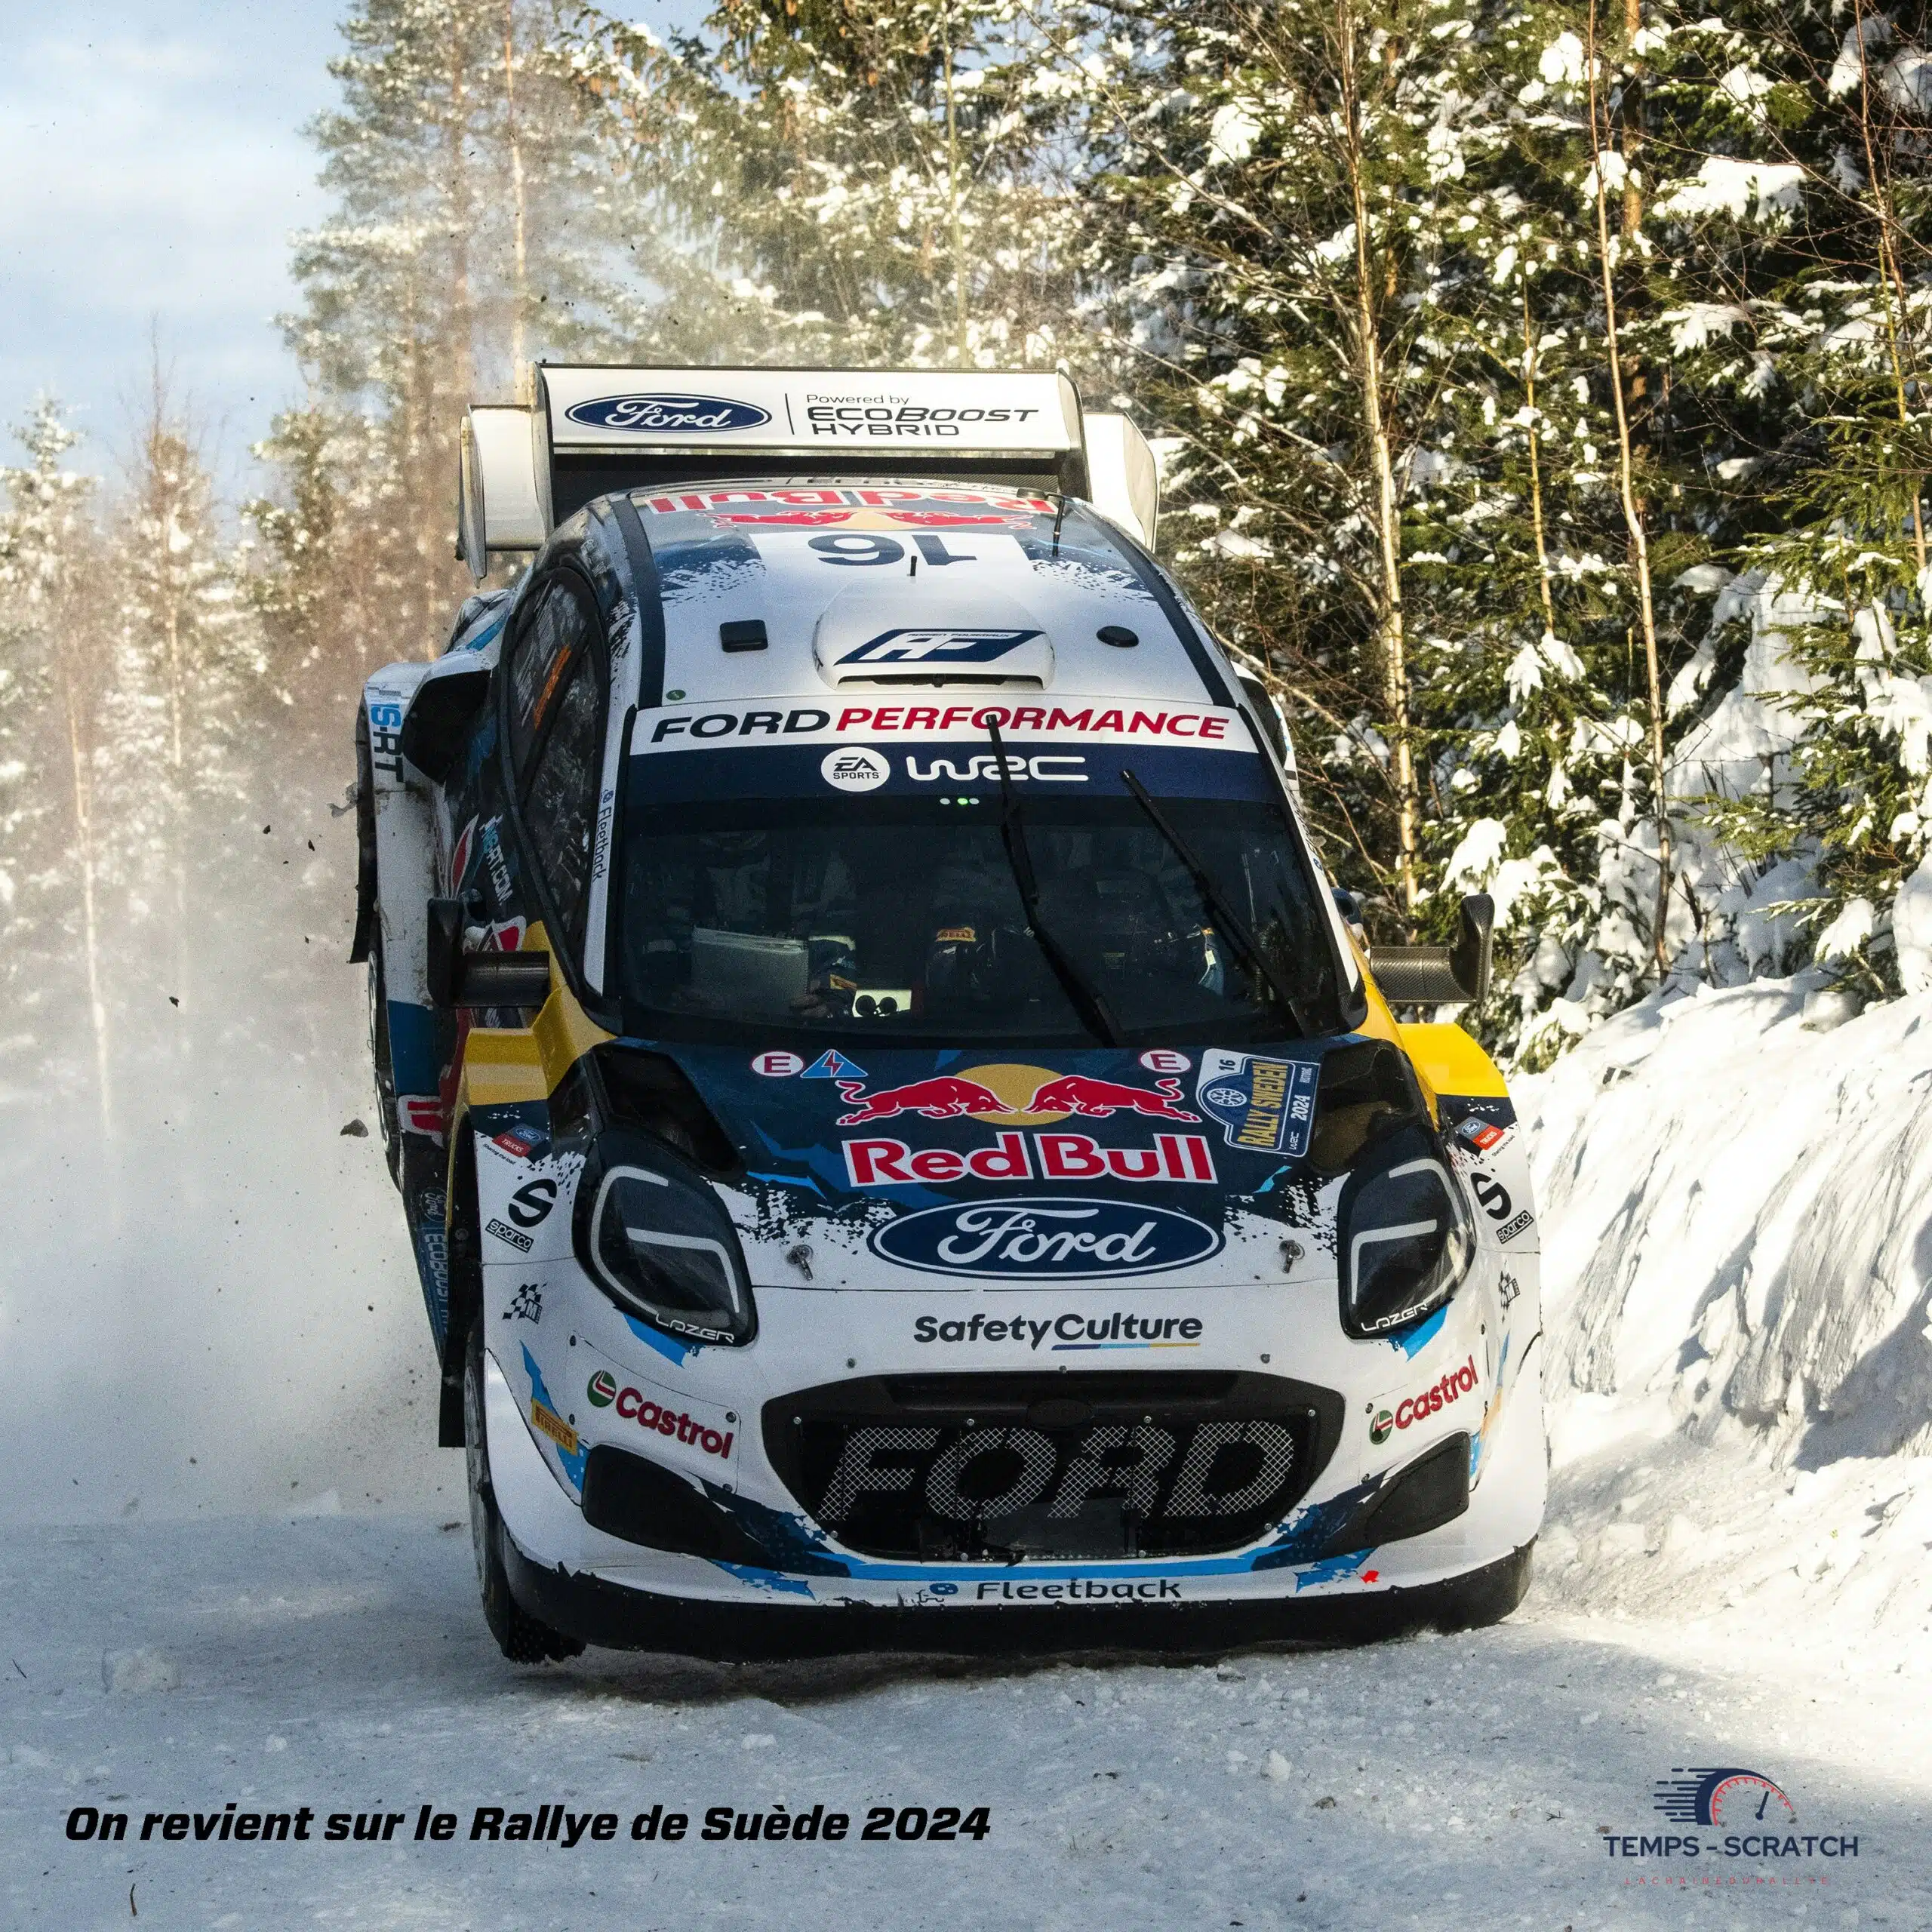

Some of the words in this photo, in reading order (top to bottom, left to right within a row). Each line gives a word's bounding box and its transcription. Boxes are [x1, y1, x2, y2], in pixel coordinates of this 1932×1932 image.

[608, 398, 731, 429] Ford
[807, 394, 884, 405] Powered
[888, 395, 909, 405] by
[808, 407, 1039, 423] ECOBOOST
[811, 423, 959, 436] HYBRID
[645, 489, 849, 514] Bull
[861, 490, 1059, 515] Red
[808, 534, 978, 567] 16
[649, 708, 832, 743] FORD
[835, 706, 1230, 740] PERFORMANCE
[371, 703, 404, 783] S-RT
[832, 771, 880, 780] SPORTS
[833, 756, 878, 771] EA
[906, 755, 1089, 781] WRC
[593, 806, 614, 882] Fleetback
[764, 1055, 792, 1074] E
[1149, 1054, 1180, 1070] E
[1219, 1059, 1236, 1071] 16
[1251, 1061, 1289, 1109] SWEDEN
[1291, 1094, 1311, 1121] 2024
[1237, 1109, 1281, 1147] RALLY
[502, 1139, 524, 1152] TRUCKS
[841, 1131, 1035, 1187] Red
[1033, 1134, 1218, 1184] Bull
[487, 1218, 533, 1250] sparco
[937, 1208, 1158, 1263] Ford
[1497, 1211, 1534, 1244] sparco
[655, 1312, 735, 1343] LAZER
[914, 1312, 1203, 1350] SafetyCulture
[1361, 1302, 1429, 1332] LAZER
[1394, 1355, 1479, 1430] Castrol
[615, 1387, 734, 1460] Castrol
[818, 1421, 1295, 1522] FORD
[977, 1579, 1182, 1601] Fleetback
